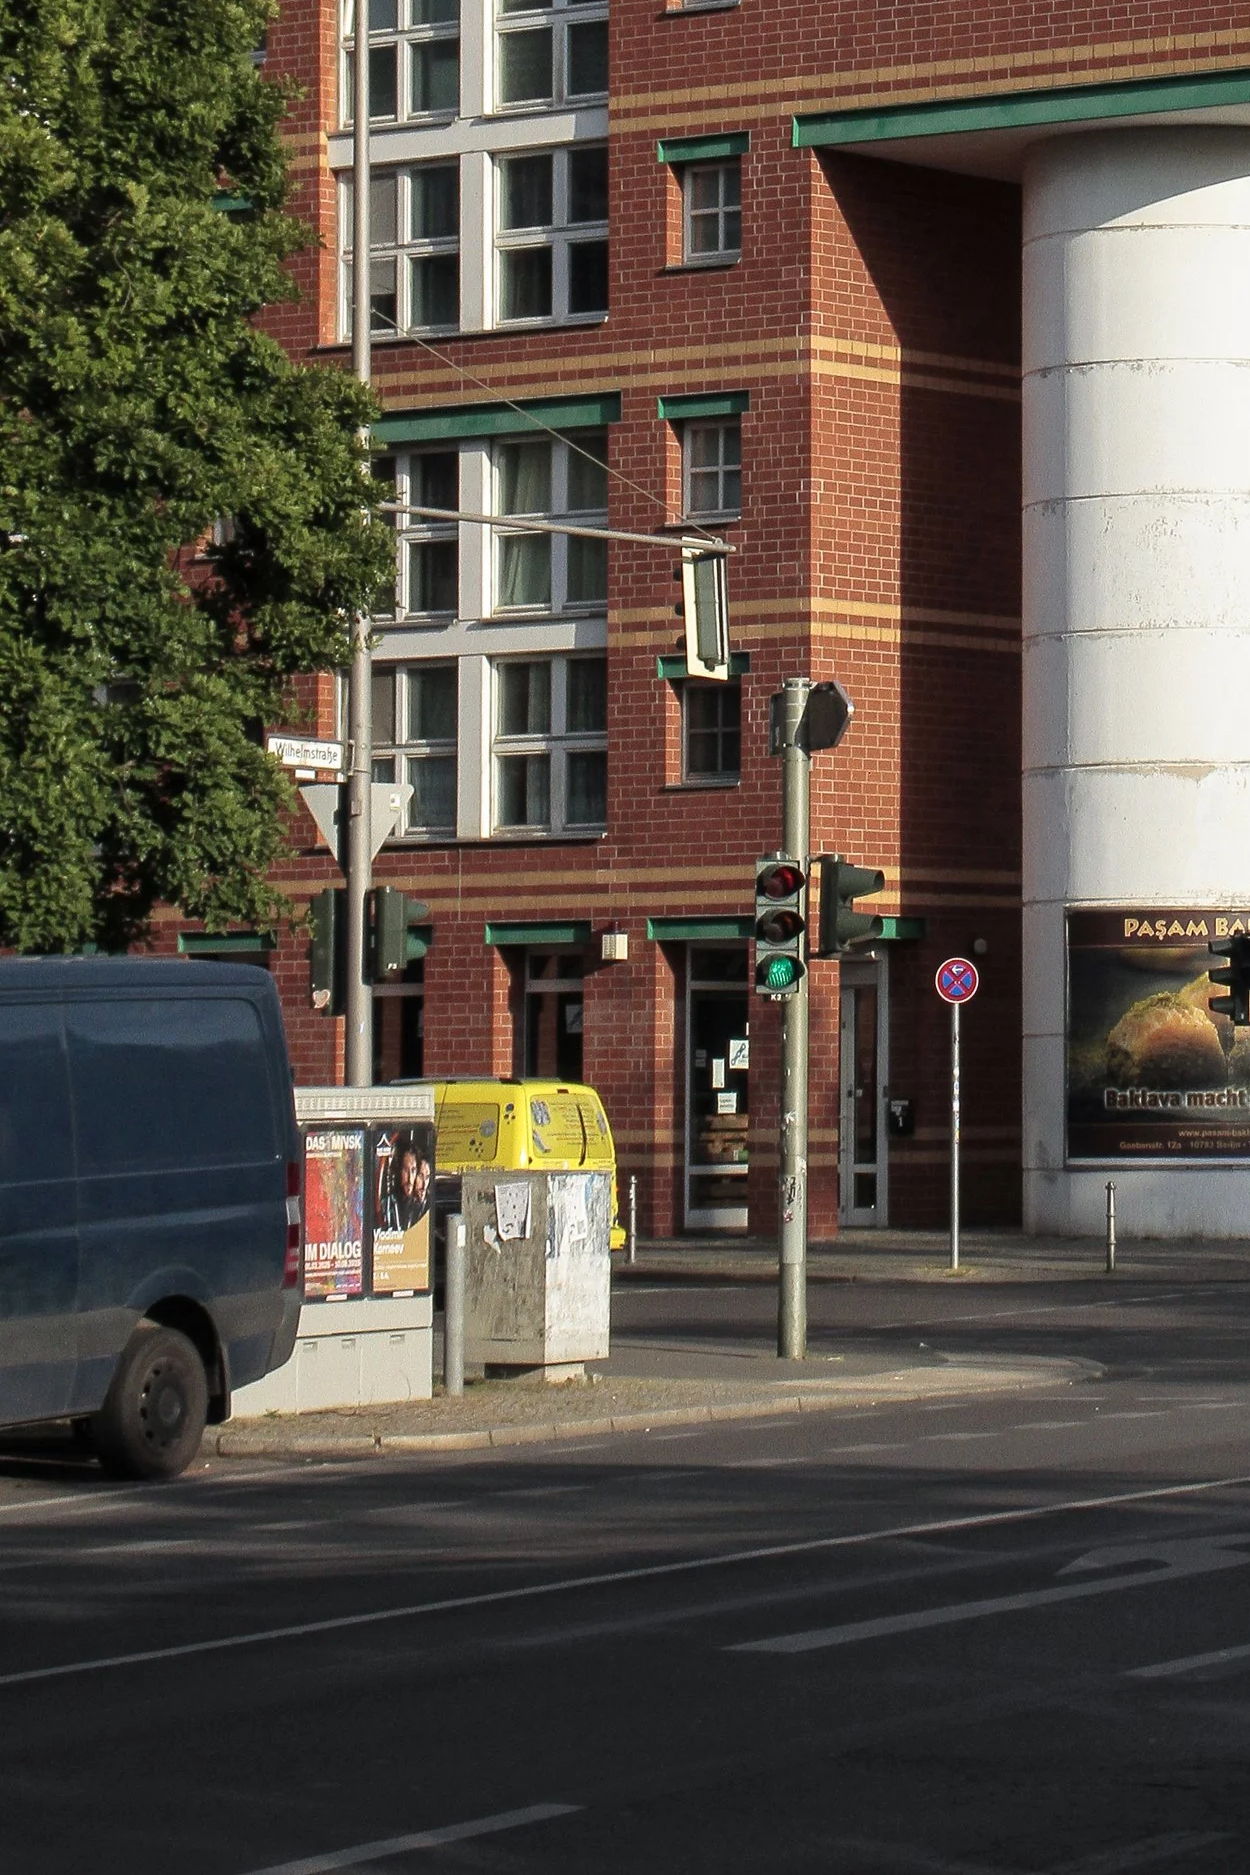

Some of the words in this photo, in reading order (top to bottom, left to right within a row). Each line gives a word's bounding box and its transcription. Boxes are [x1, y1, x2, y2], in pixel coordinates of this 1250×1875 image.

[275, 740, 338, 765] Wilhelmstraße
[1124, 918, 1209, 941] PAŞAM
[1104, 1086, 1181, 1109] Baklava
[1185, 1086, 1246, 1108] macht
[305, 1135, 326, 1151] DAS
[331, 1134, 362, 1150] MINSK
[304, 1243, 318, 1261] IM
[319, 1240, 362, 1260] DIALOG
